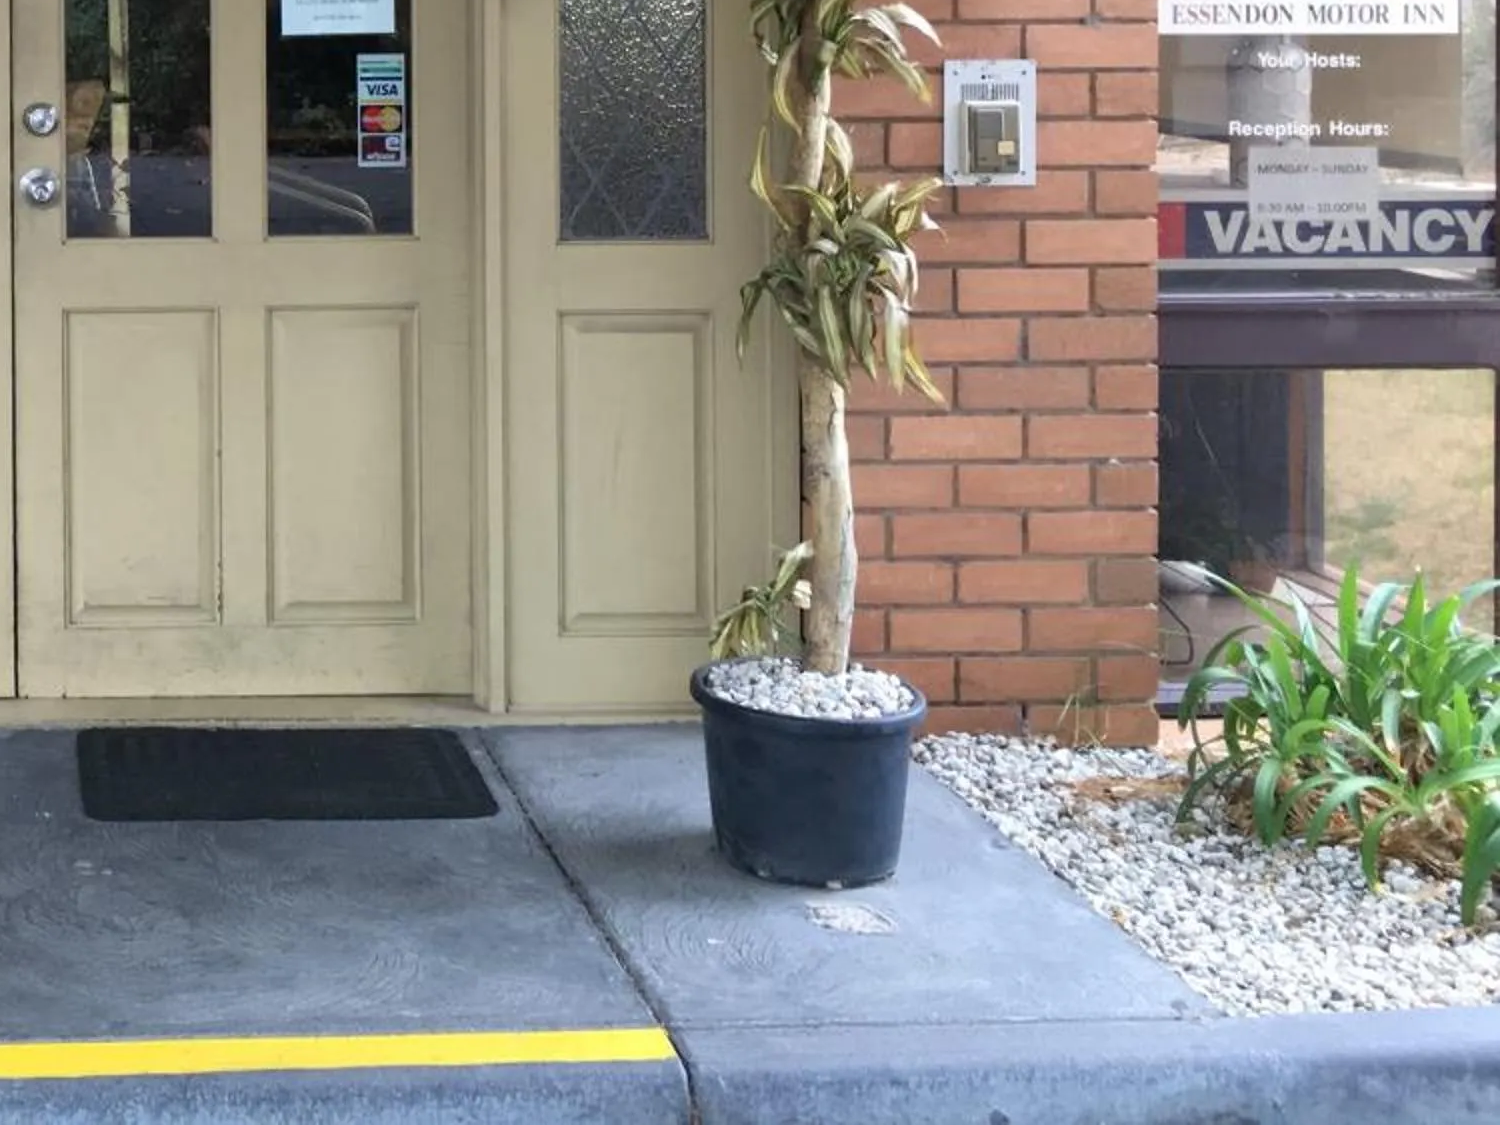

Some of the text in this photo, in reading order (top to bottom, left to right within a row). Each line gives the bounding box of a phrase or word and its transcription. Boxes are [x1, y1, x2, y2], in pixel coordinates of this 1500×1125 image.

[1172, 3, 1446, 25] ESSENDON MOTOR INN
[1305, 51, 1361, 68] Hosts:
[366, 83, 398, 95] VISA
[1229, 120, 1389, 140] Reception Hours:
[1257, 163, 1309, 174] MONDAY
[1322, 163, 1368, 174] SUNDAY
[1203, 208, 1495, 254] VACANCY
